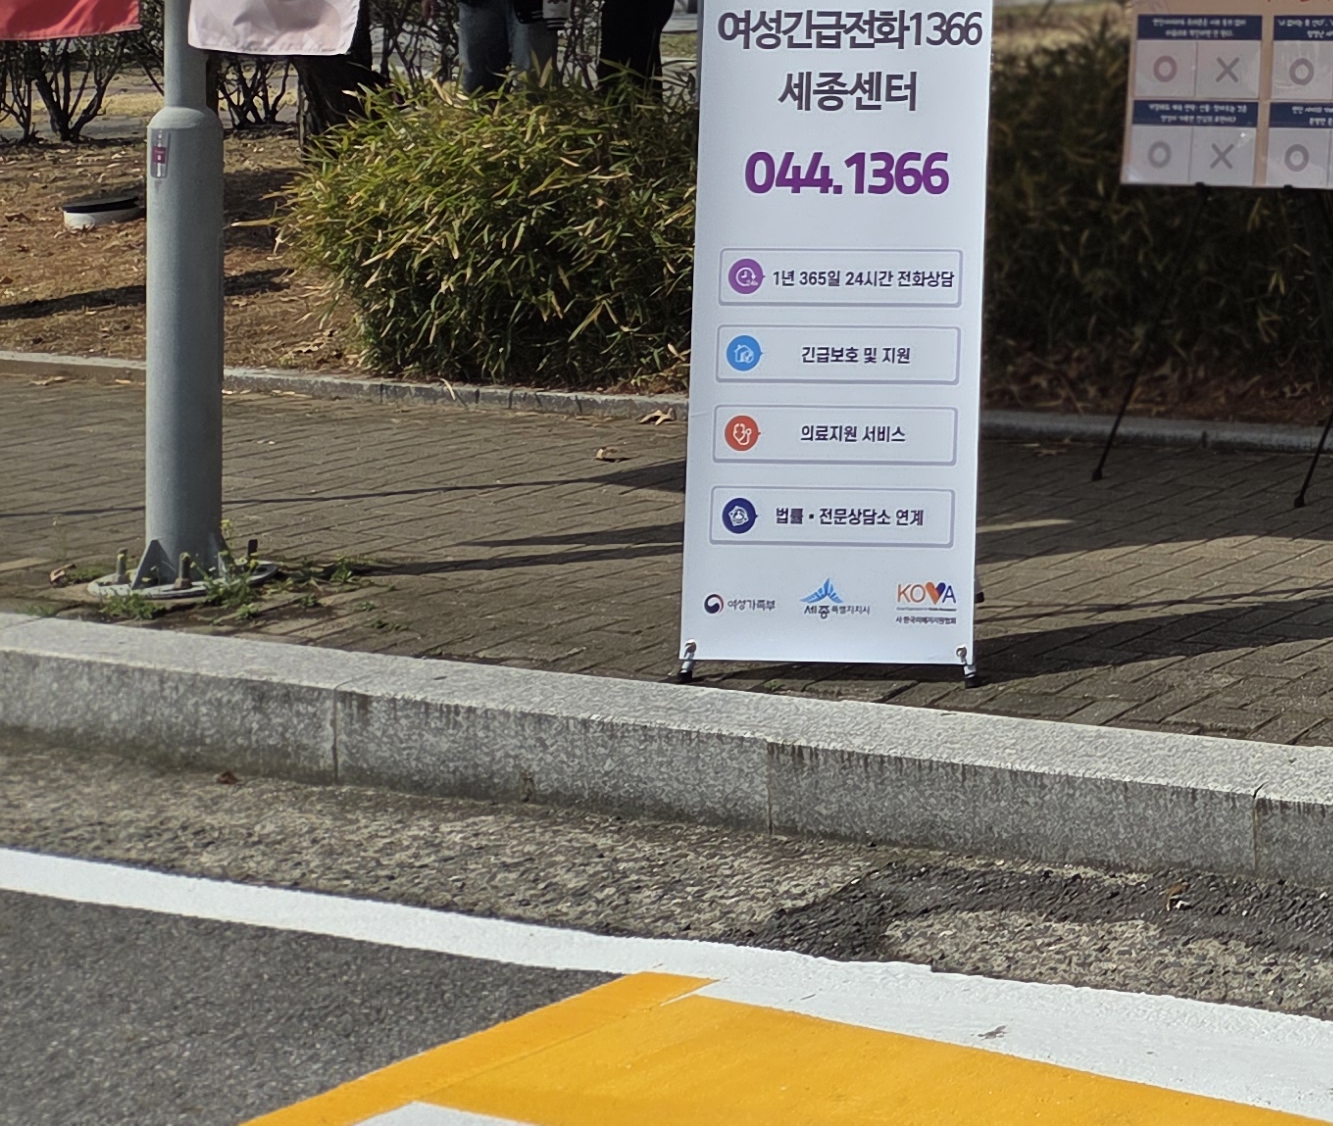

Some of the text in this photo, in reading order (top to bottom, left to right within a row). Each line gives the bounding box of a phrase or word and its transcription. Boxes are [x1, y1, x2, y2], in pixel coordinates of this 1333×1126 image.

[717, 9, 983, 50] 여성긴급전화1366
[778, 71, 917, 112] 세종센터
[745, 151, 950, 195] 044.1366
[773, 270, 955, 288] 1년 365일 24시간 전화상담
[802, 347, 911, 364] 긴급보호 및 지원
[800, 425, 906, 443] 의료지원 서비스
[776, 507, 924, 526] 법률 전문상담소 연계
[897, 582, 957, 605] KOVA
[727, 599, 776, 611] 여성가족부
